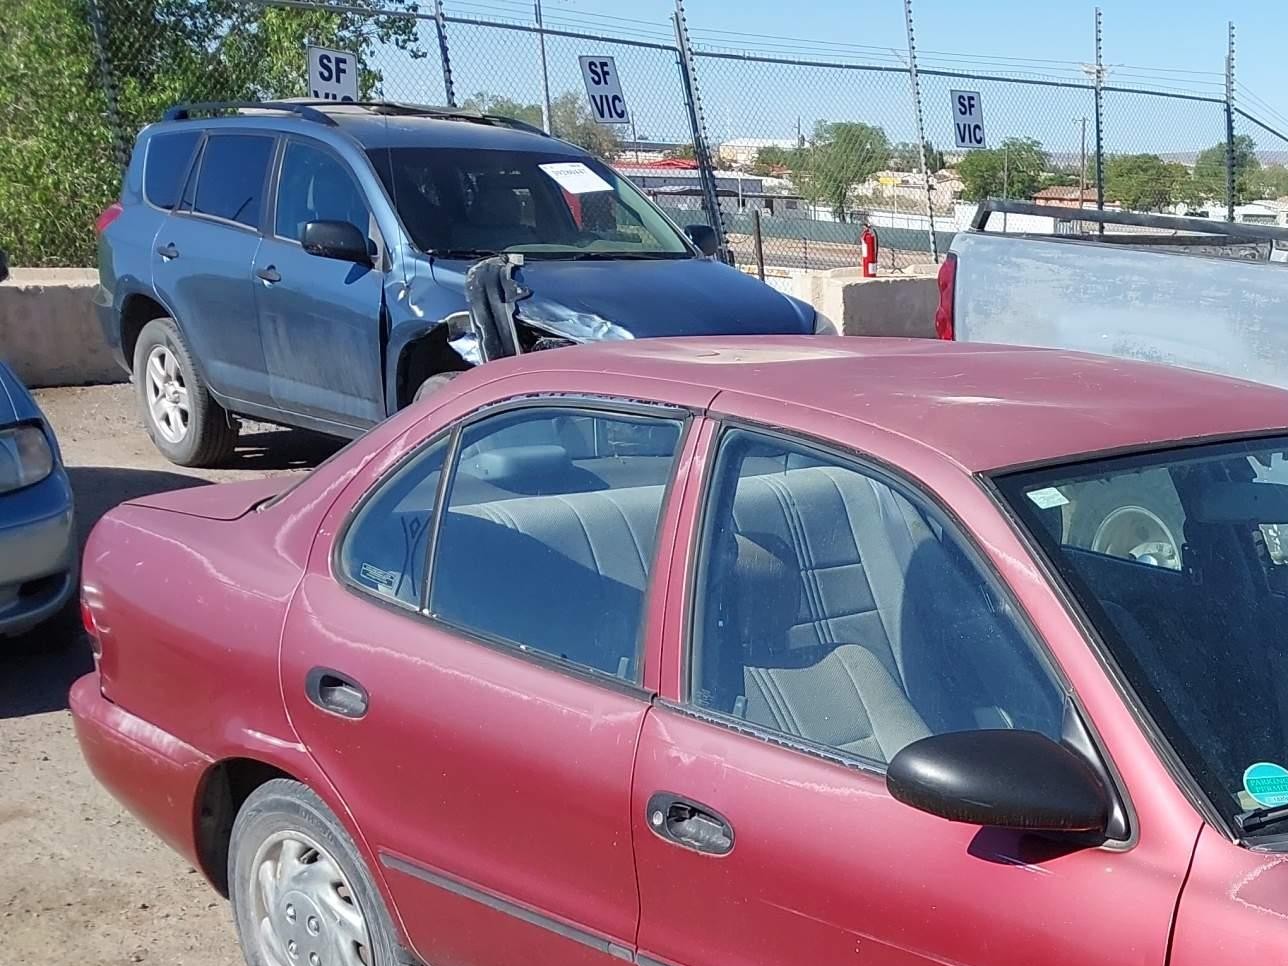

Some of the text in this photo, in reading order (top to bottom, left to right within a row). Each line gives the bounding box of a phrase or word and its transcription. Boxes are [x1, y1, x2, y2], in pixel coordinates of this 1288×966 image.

[318, 53, 347, 84] SF
[588, 60, 610, 86] SF
[591, 94, 625, 119] VIC
[957, 94, 976, 116] SF
[956, 122, 983, 145] VIC
